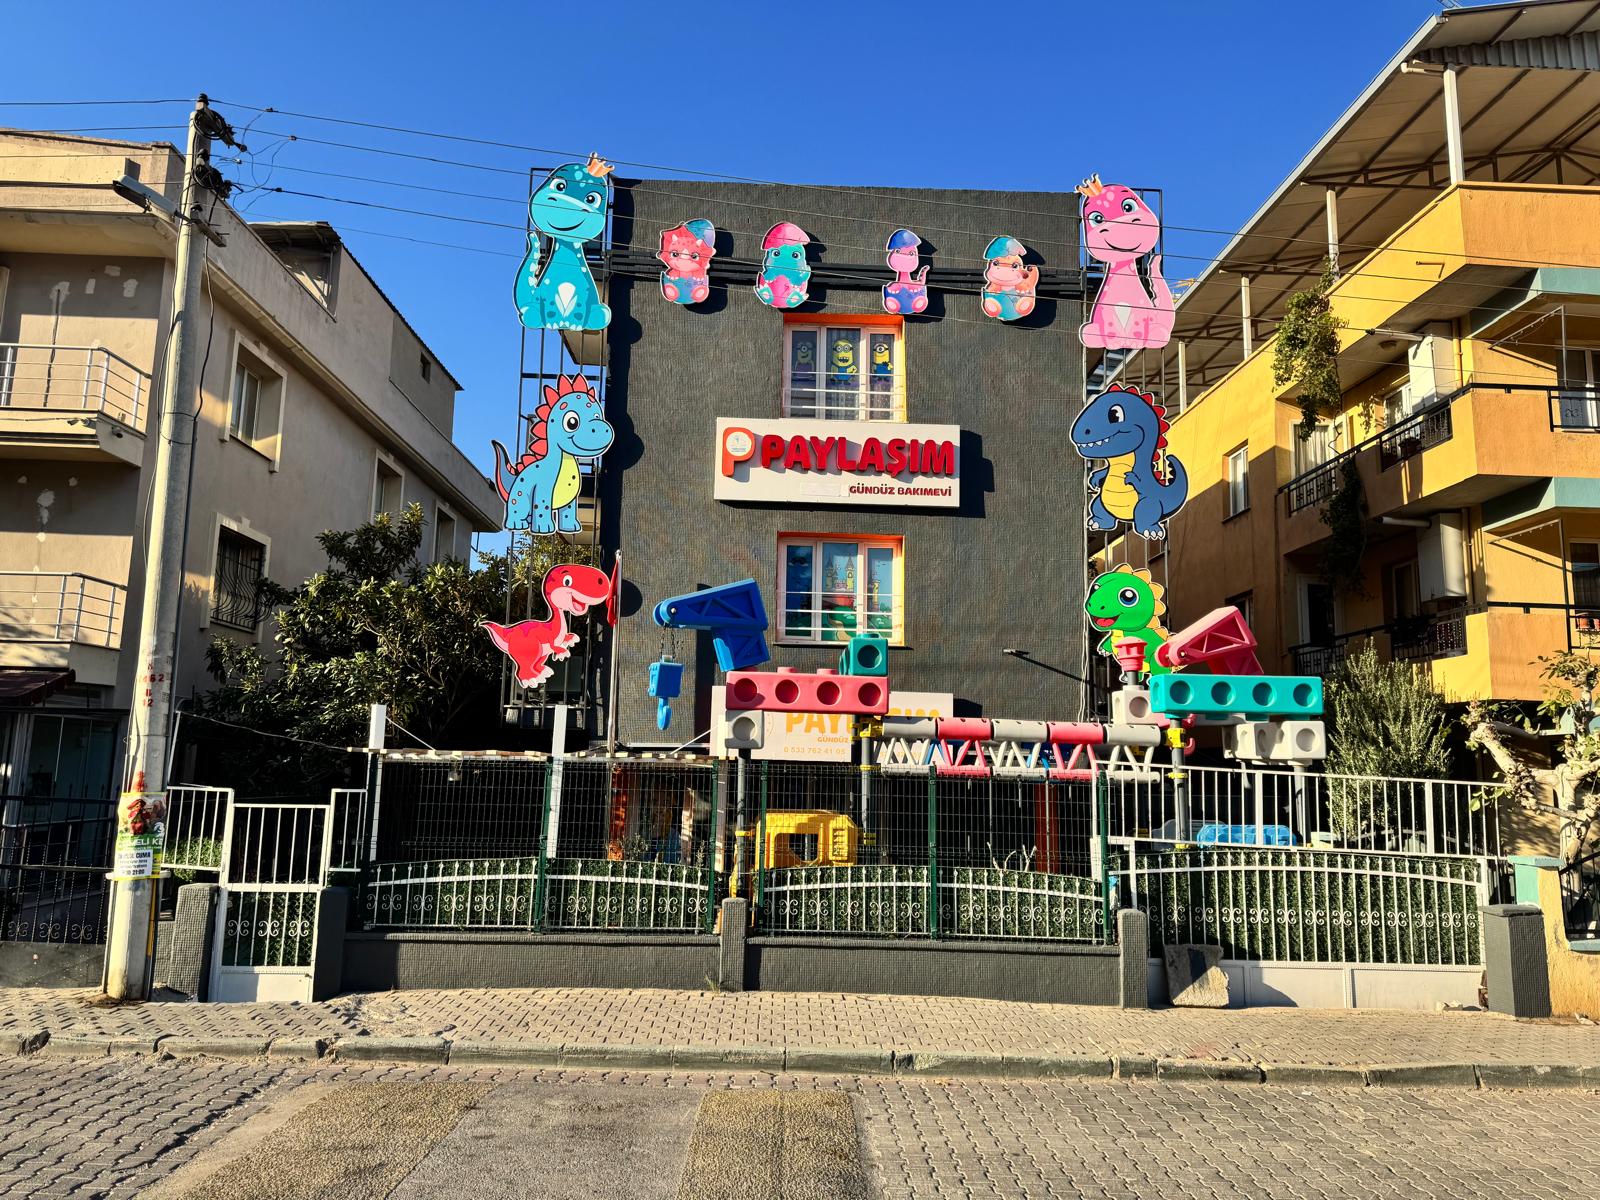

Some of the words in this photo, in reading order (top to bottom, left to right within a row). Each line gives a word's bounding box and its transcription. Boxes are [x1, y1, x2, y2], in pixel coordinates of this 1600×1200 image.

[760, 434, 954, 477] PAYLAŞIM
[849, 483, 895, 496] GÜNDÜZ
[897, 486, 952, 497] BAKIMEVİ
[817, 735, 848, 743] GÜNDÜZ
